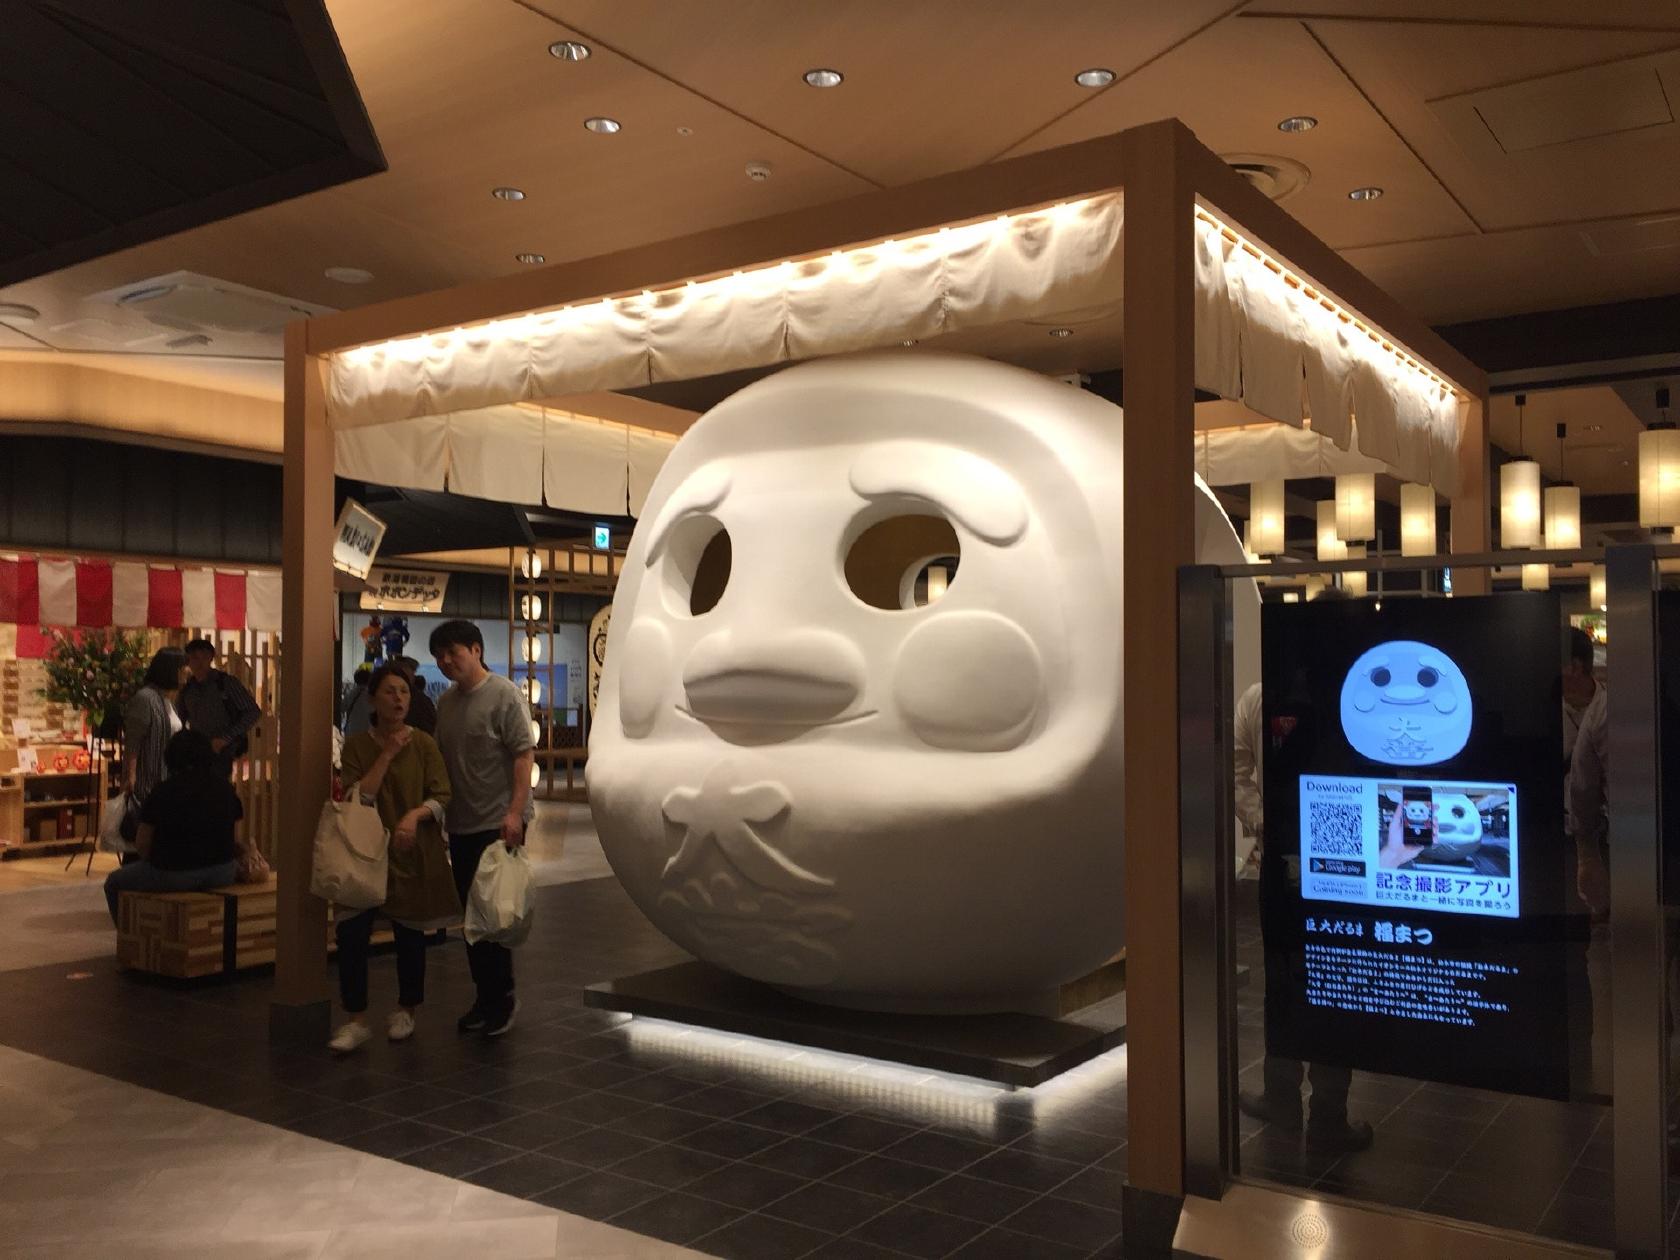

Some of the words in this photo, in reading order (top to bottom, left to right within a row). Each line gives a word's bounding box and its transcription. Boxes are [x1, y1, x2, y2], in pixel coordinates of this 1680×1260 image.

[1306, 781, 1363, 794] Download
[1325, 863, 1347, 874] Google
[1376, 871, 1511, 899] 記念撮影アプリ
[1305, 917, 1364, 938] 巨大だるま
